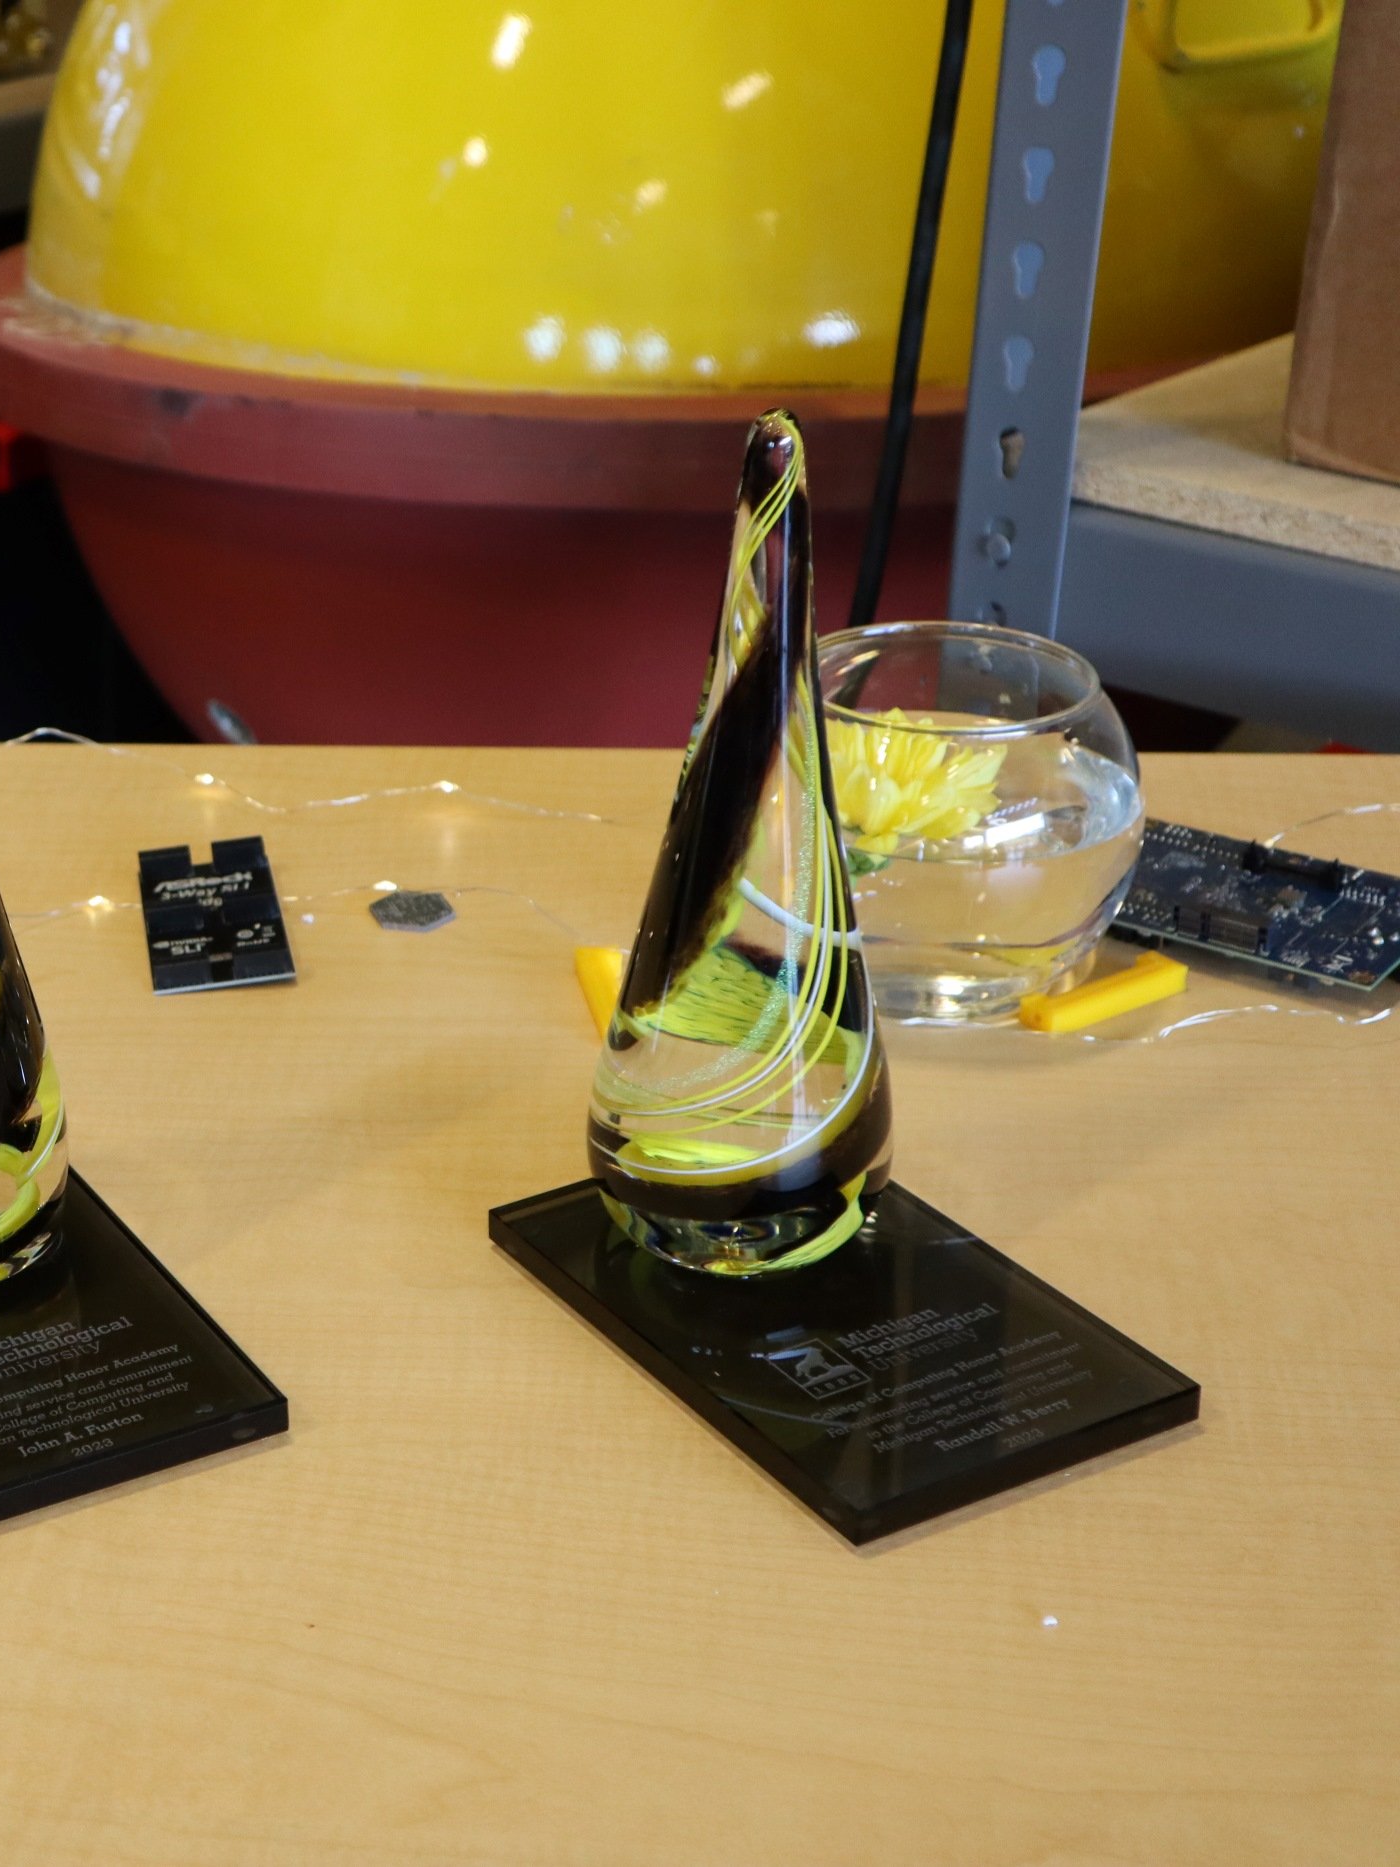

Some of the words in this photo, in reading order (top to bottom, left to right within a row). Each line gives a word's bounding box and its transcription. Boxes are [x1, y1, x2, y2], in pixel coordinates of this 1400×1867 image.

[835, 1309, 941, 1348] Michigan
[851, 1302, 1000, 1359] Technological
[867, 1328, 978, 1370] University
[25, 1391, 75, 1411] service
[78, 1380, 106, 1395] and
[108, 1355, 193, 1386] commitment
[64, 1364, 110, 1382] Honor
[112, 1344, 178, 1369] Academy
[811, 1401, 866, 1421] College
[867, 1392, 882, 1404] of
[881, 1368, 959, 1397] Computing
[954, 1353, 999, 1372] Honor
[998, 1331, 1063, 1357] Academy
[18, 1402, 118, 1438] Technological
[119, 1382, 189, 1407] University
[50, 1405, 63, 1416] of
[66, 1383, 144, 1411] Computing
[147, 1372, 175, 1387] and
[825, 1425, 850, 1438] For
[977, 1369, 1004, 1384] and
[881, 1422, 905, 1434] the
[905, 1403, 957, 1425] College
[958, 1396, 973, 1407] of
[1046, 1360, 1073, 1375] and
[17, 1439, 61, 1457] John
[64, 1431, 84, 1443] A.
[84, 1413, 144, 1436] Furton
[71, 1438, 114, 1457] 2023
[873, 1426, 938, 1453] Michigan
[934, 1420, 1004, 1451] Randall
[998, 1413, 1025, 1426] W.
